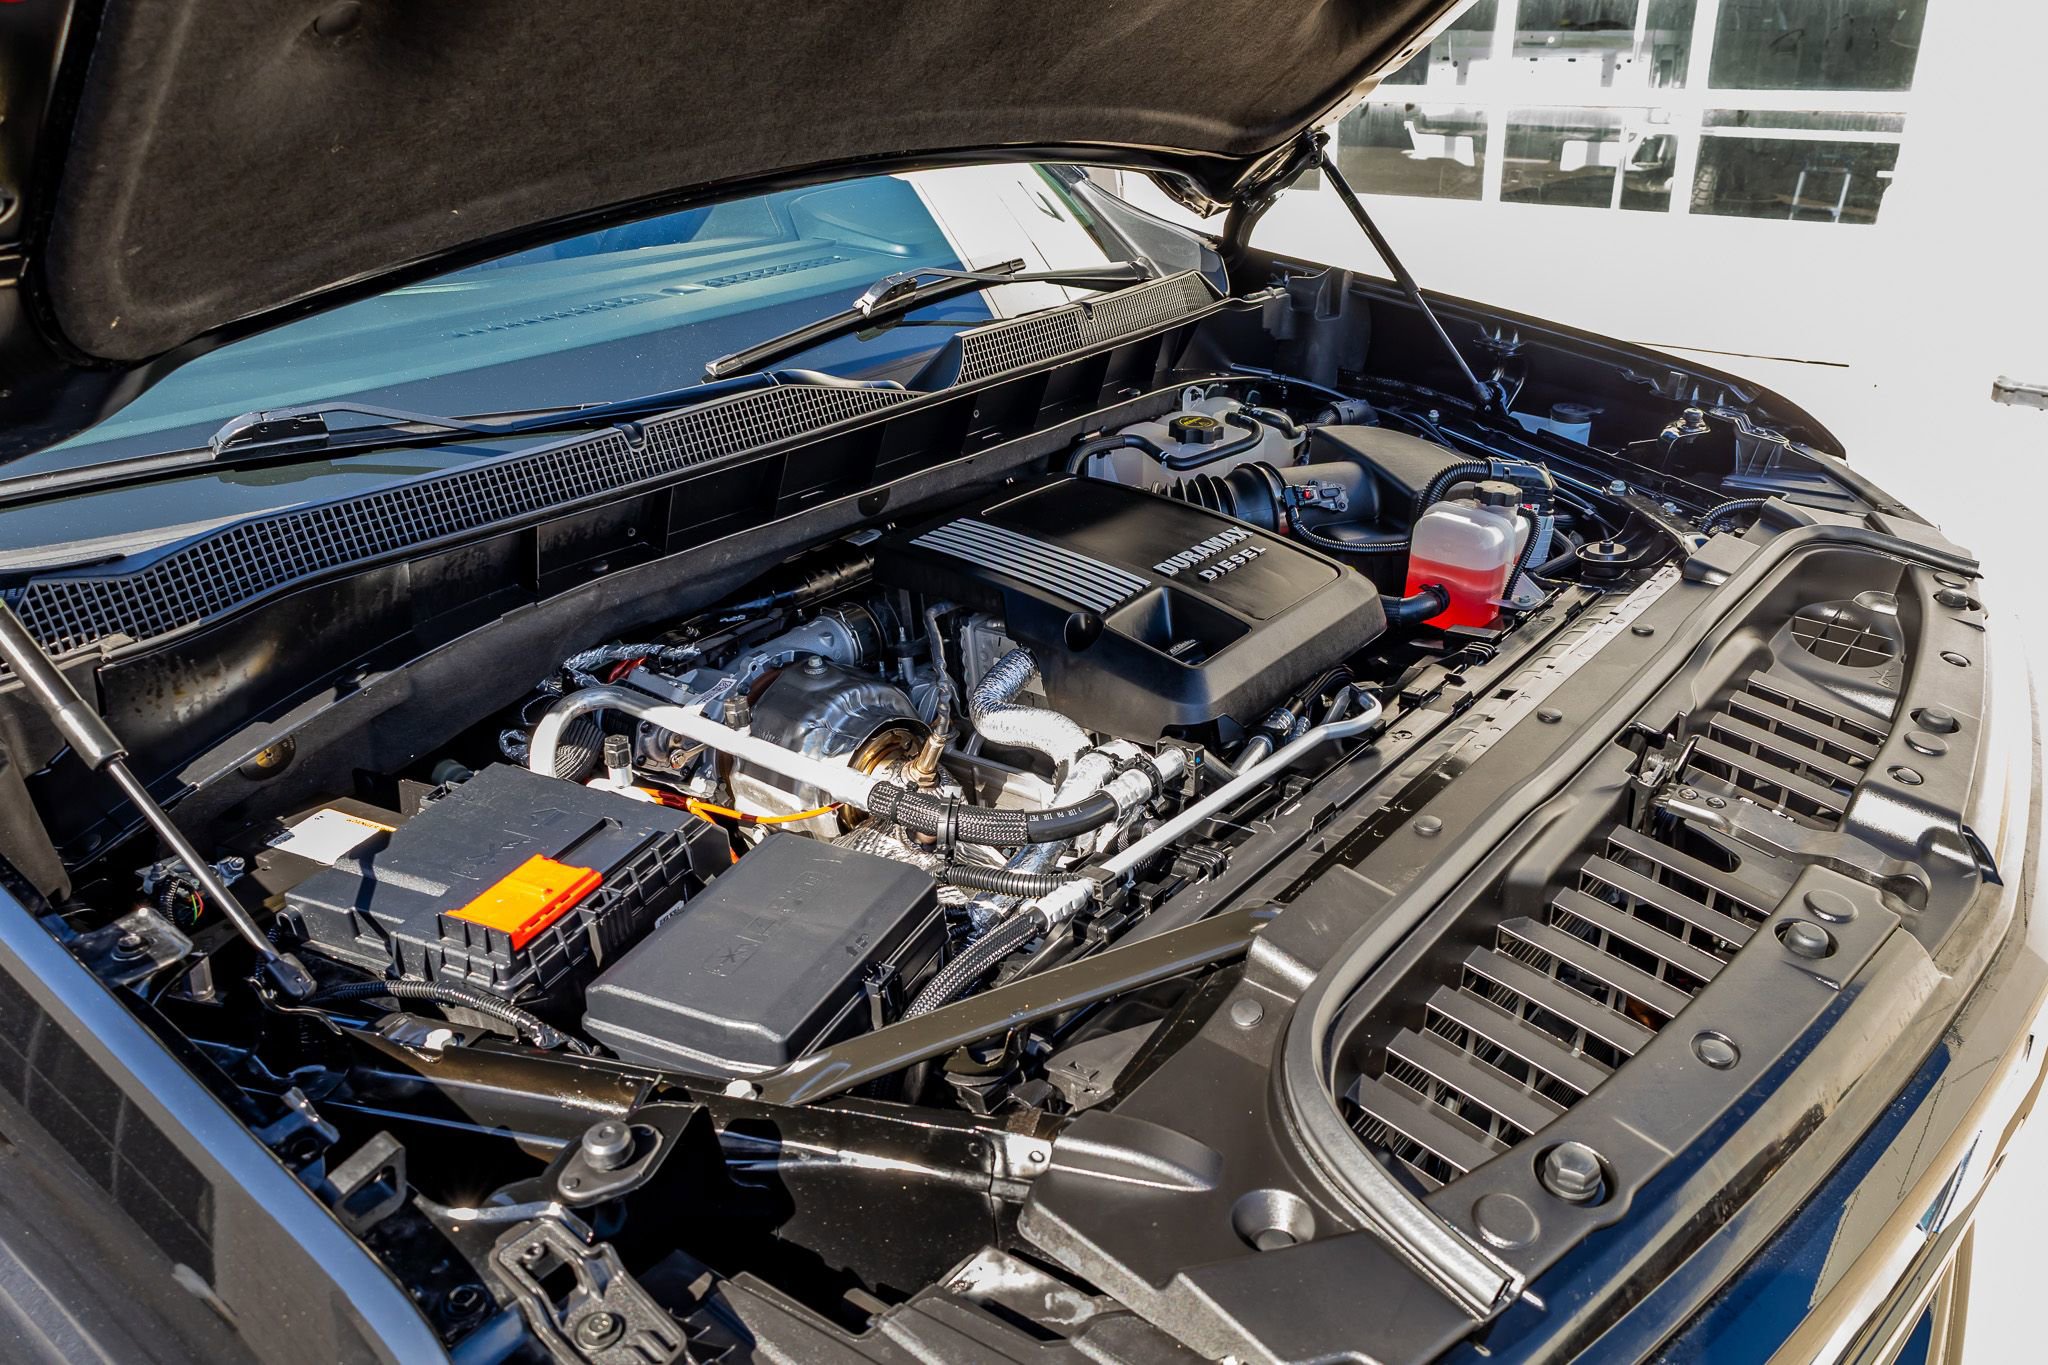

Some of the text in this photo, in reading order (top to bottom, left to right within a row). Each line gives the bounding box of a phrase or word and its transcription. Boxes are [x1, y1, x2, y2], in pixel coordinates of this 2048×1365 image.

[1152, 526, 1254, 577] DURAMAX
[1198, 545, 1267, 582] DIESEL
[1029, 814, 1039, 822] PET
